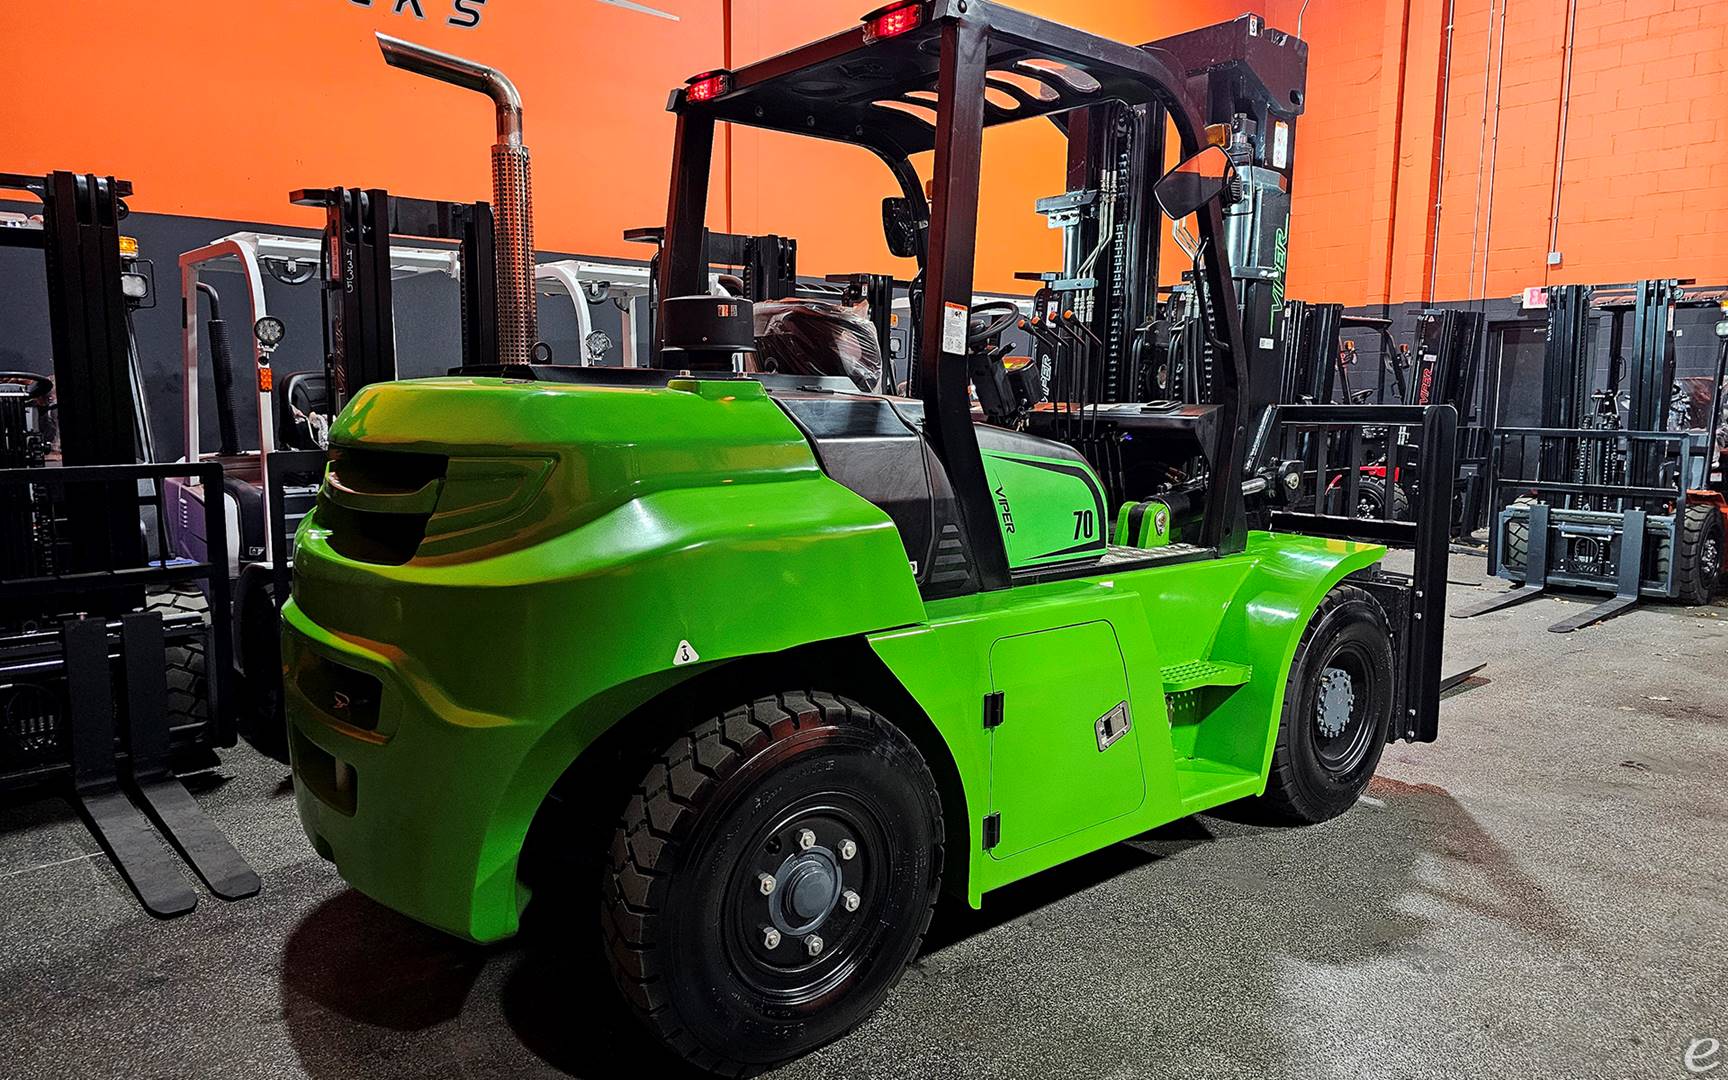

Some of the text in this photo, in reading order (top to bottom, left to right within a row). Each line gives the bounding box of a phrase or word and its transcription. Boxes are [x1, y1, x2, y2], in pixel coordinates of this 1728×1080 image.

[345, 248, 355, 293] 4335
[994, 480, 1016, 540] VIPER
[1072, 509, 1094, 541] 70
